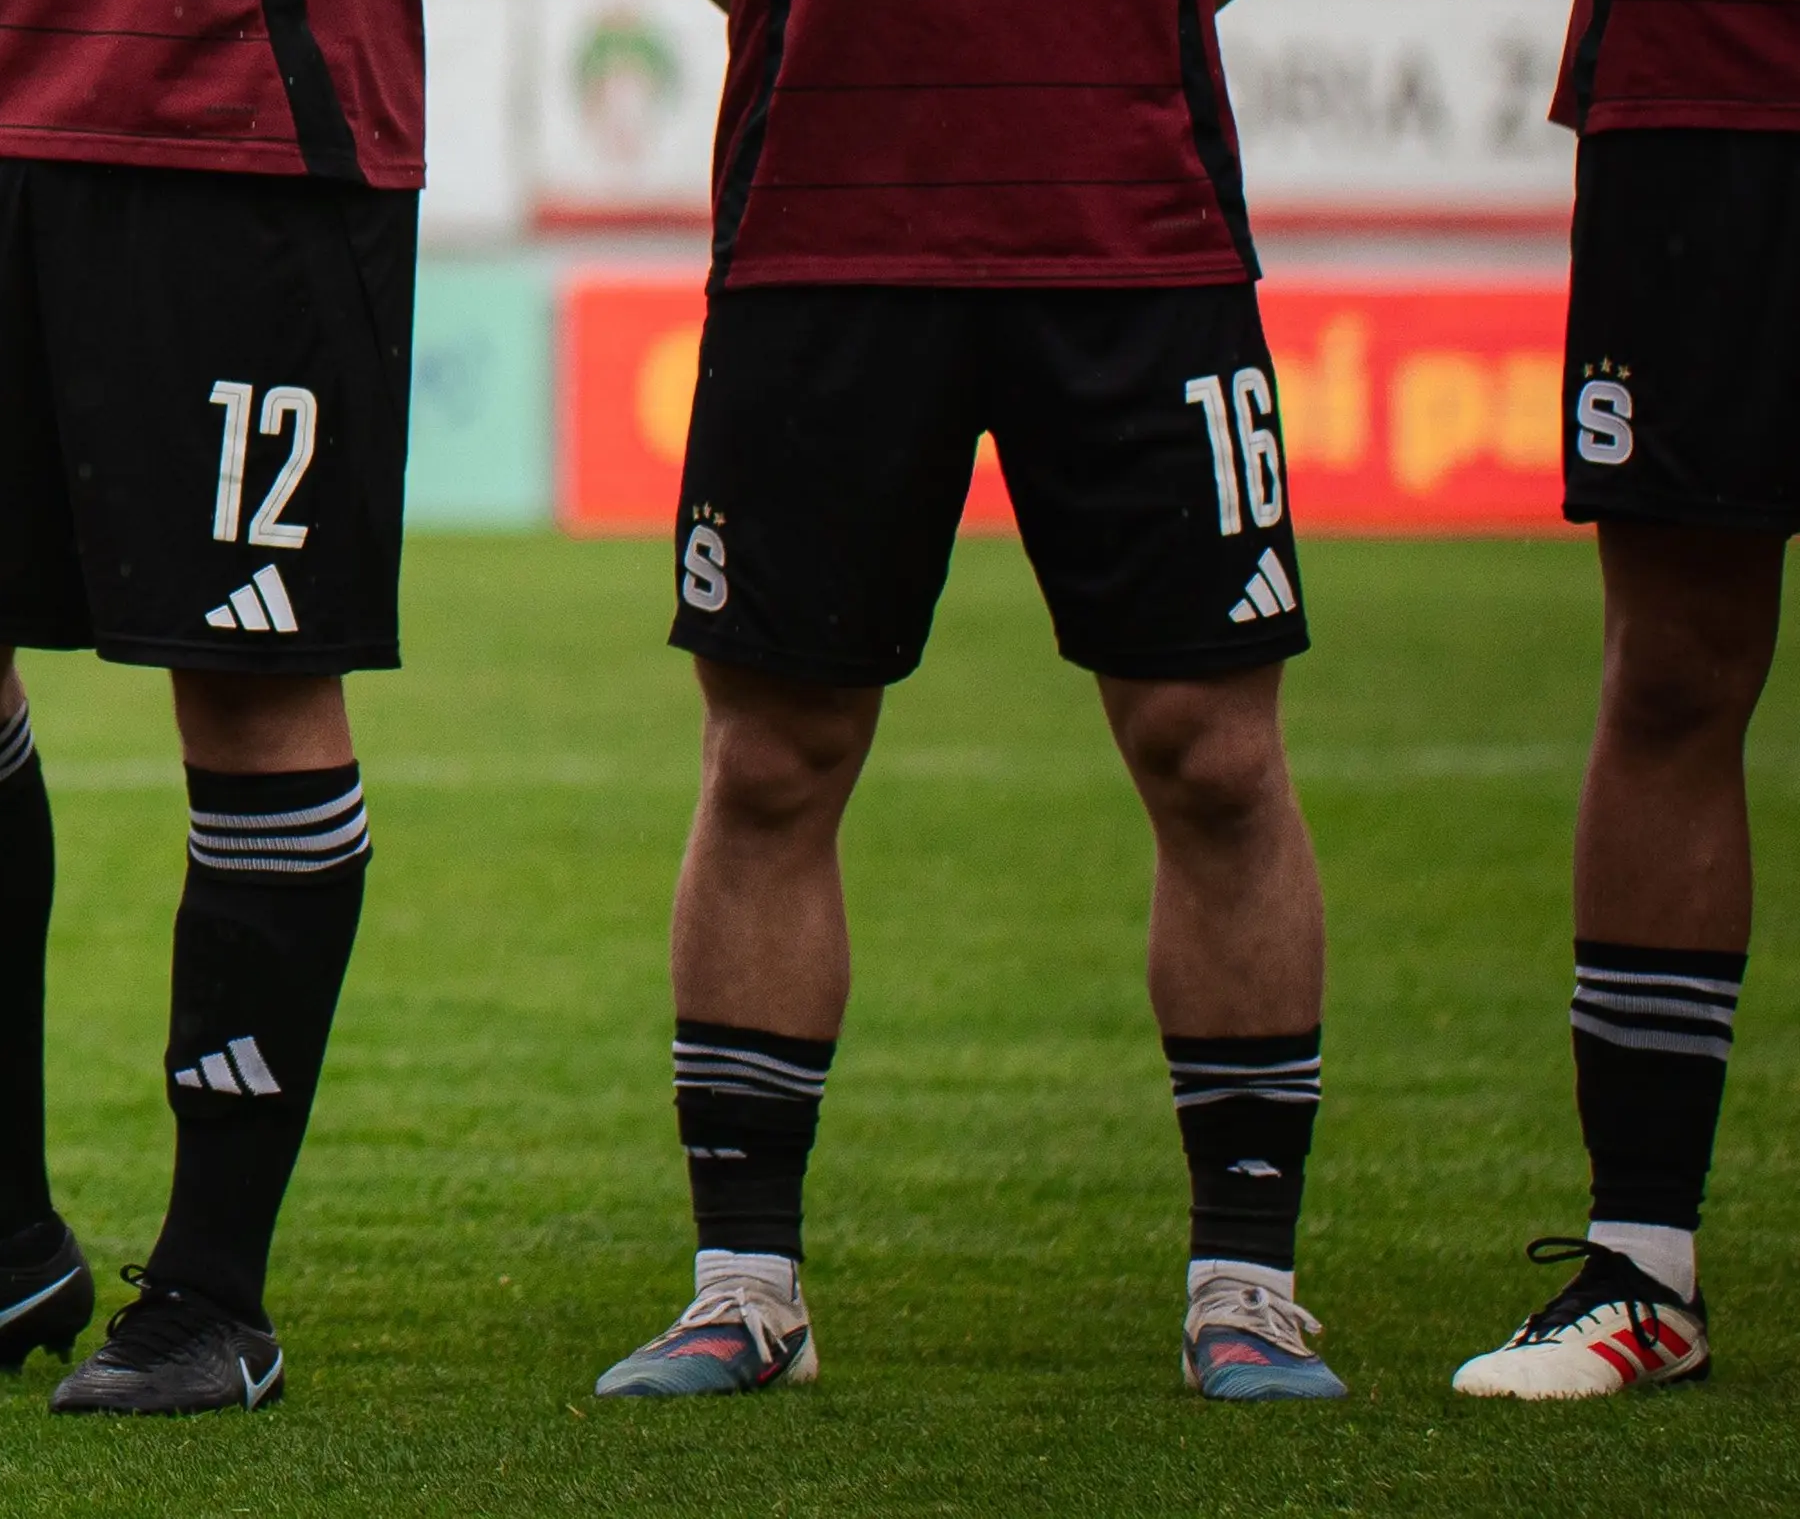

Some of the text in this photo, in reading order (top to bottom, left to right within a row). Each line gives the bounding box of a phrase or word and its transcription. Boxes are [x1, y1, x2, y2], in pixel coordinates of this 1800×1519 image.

[208, 379, 318, 549] 12
[1184, 366, 1283, 537] 16
[1577, 380, 1633, 464] S
[682, 524, 727, 612] S
